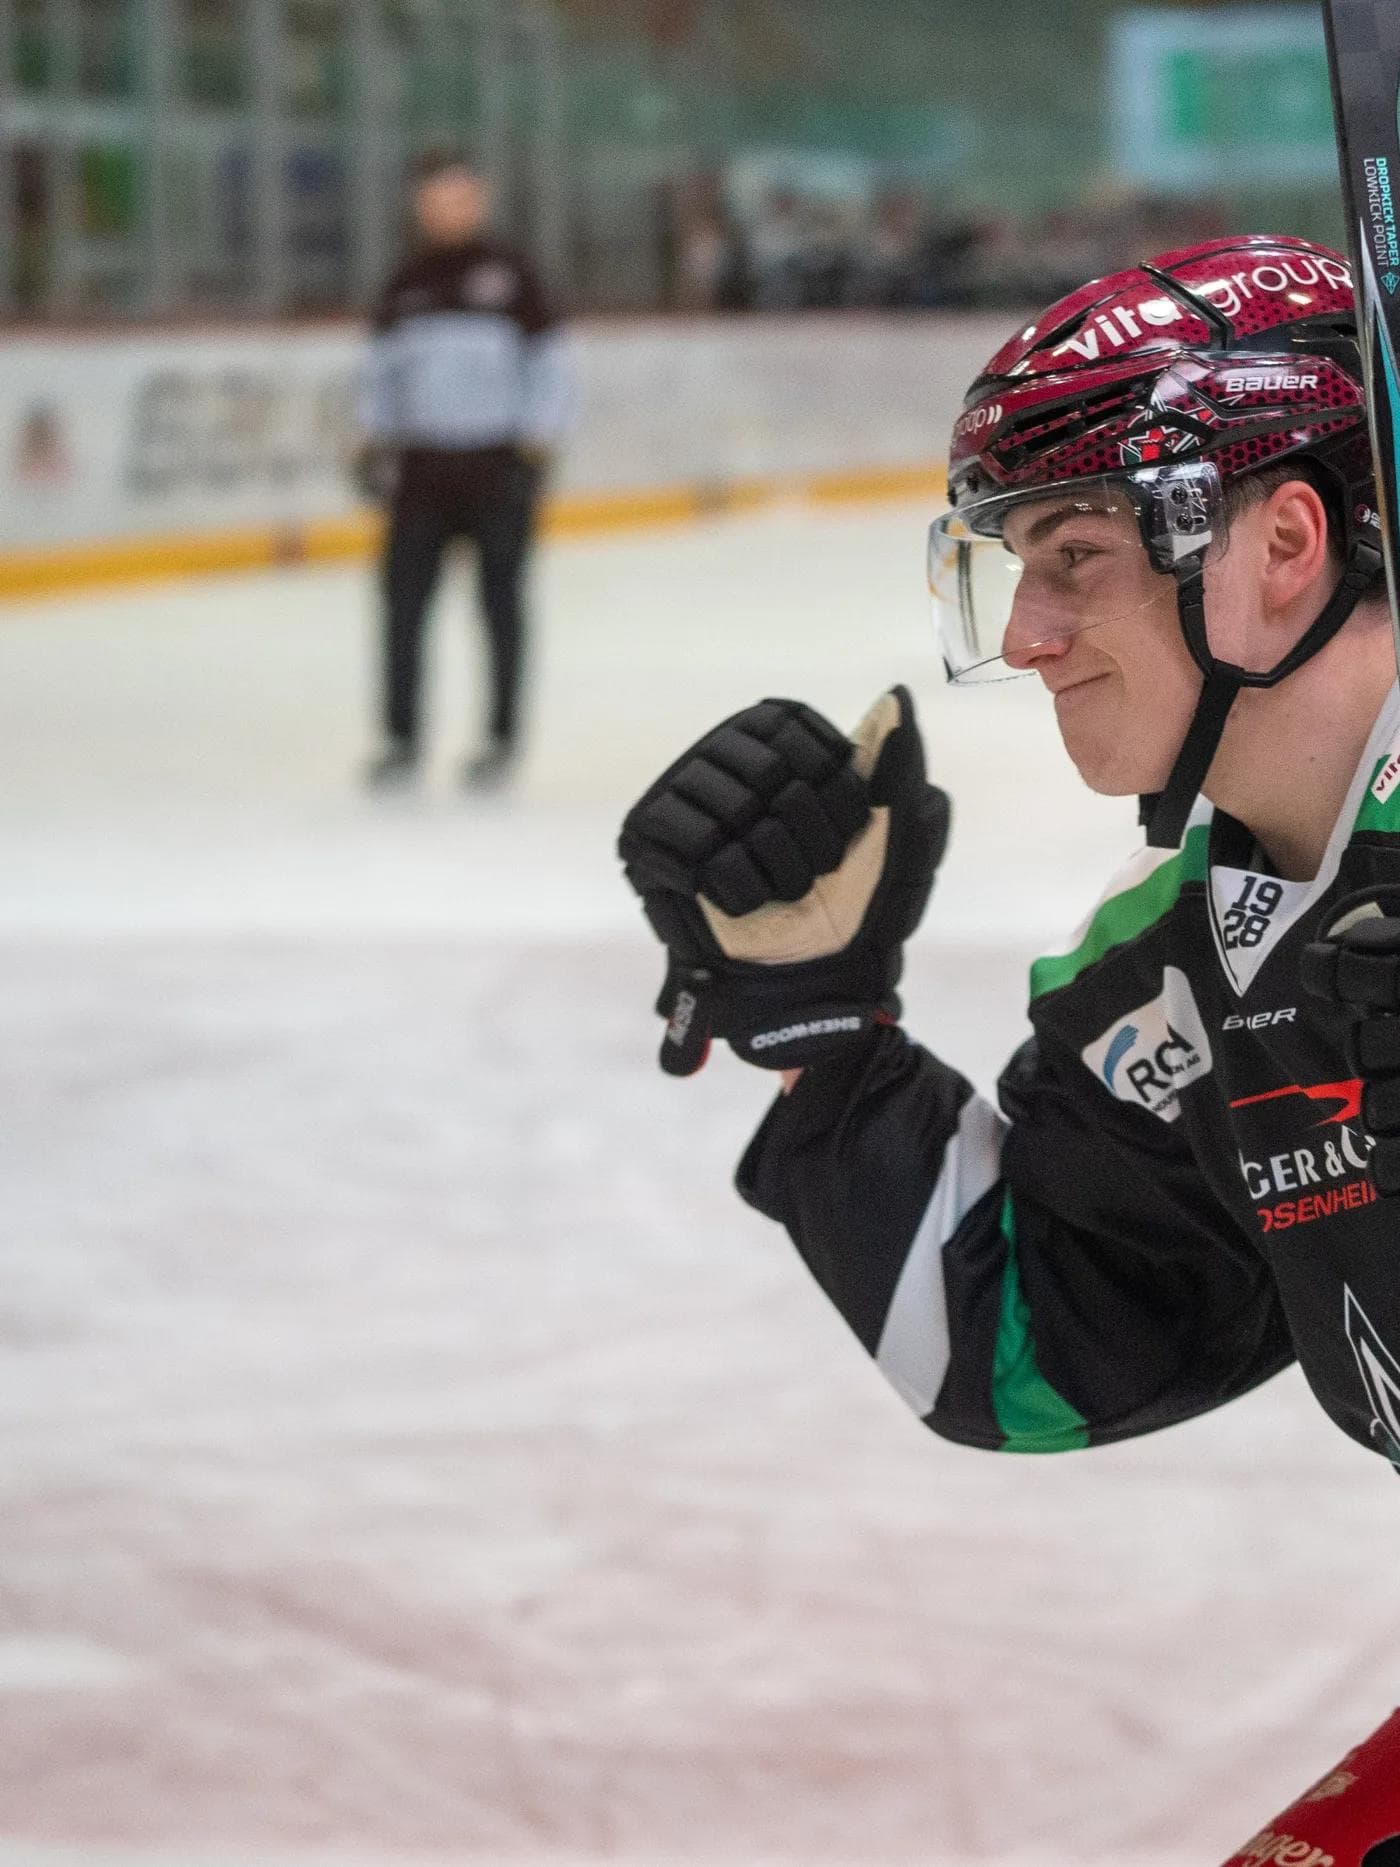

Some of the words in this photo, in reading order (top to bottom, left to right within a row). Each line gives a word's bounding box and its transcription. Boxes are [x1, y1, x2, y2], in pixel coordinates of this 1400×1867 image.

[1364, 157, 1383, 221] LOWKICK
[1376, 157, 1395, 223] DROPKICK
[1373, 224, 1389, 267] POINT
[1385, 224, 1400, 266] TAPER
[1231, 875, 1284, 917] 19
[1223, 908, 1271, 950] 28
